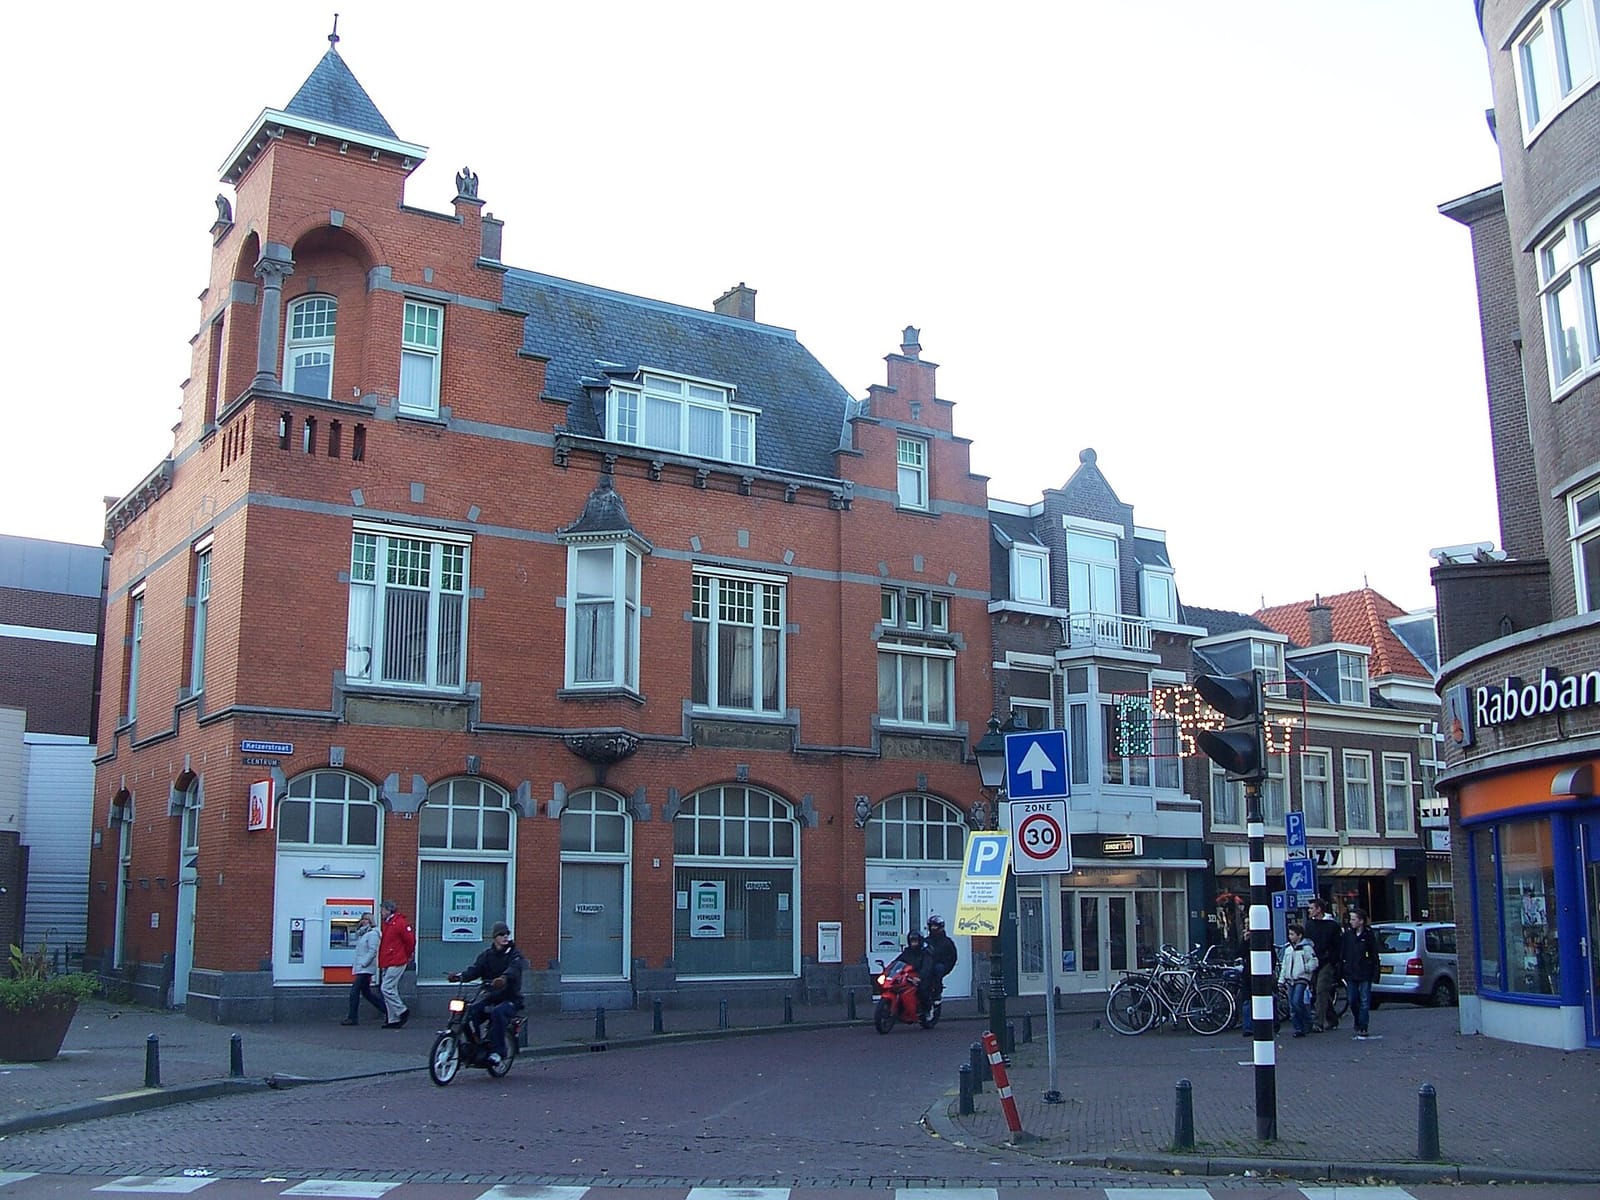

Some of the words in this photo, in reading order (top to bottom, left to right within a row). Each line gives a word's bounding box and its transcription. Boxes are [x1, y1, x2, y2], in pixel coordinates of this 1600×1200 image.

[1477, 667, 1600, 728] Raboban
[246, 742, 289, 751] Keizerstraat
[246, 758, 277, 766] CENTRUM
[1024, 803, 1052, 813] ZONE
[1289, 816, 1300, 833] P
[1027, 828, 1054, 845] 30
[974, 840, 999, 873] P
[1275, 896, 1282, 907] P
